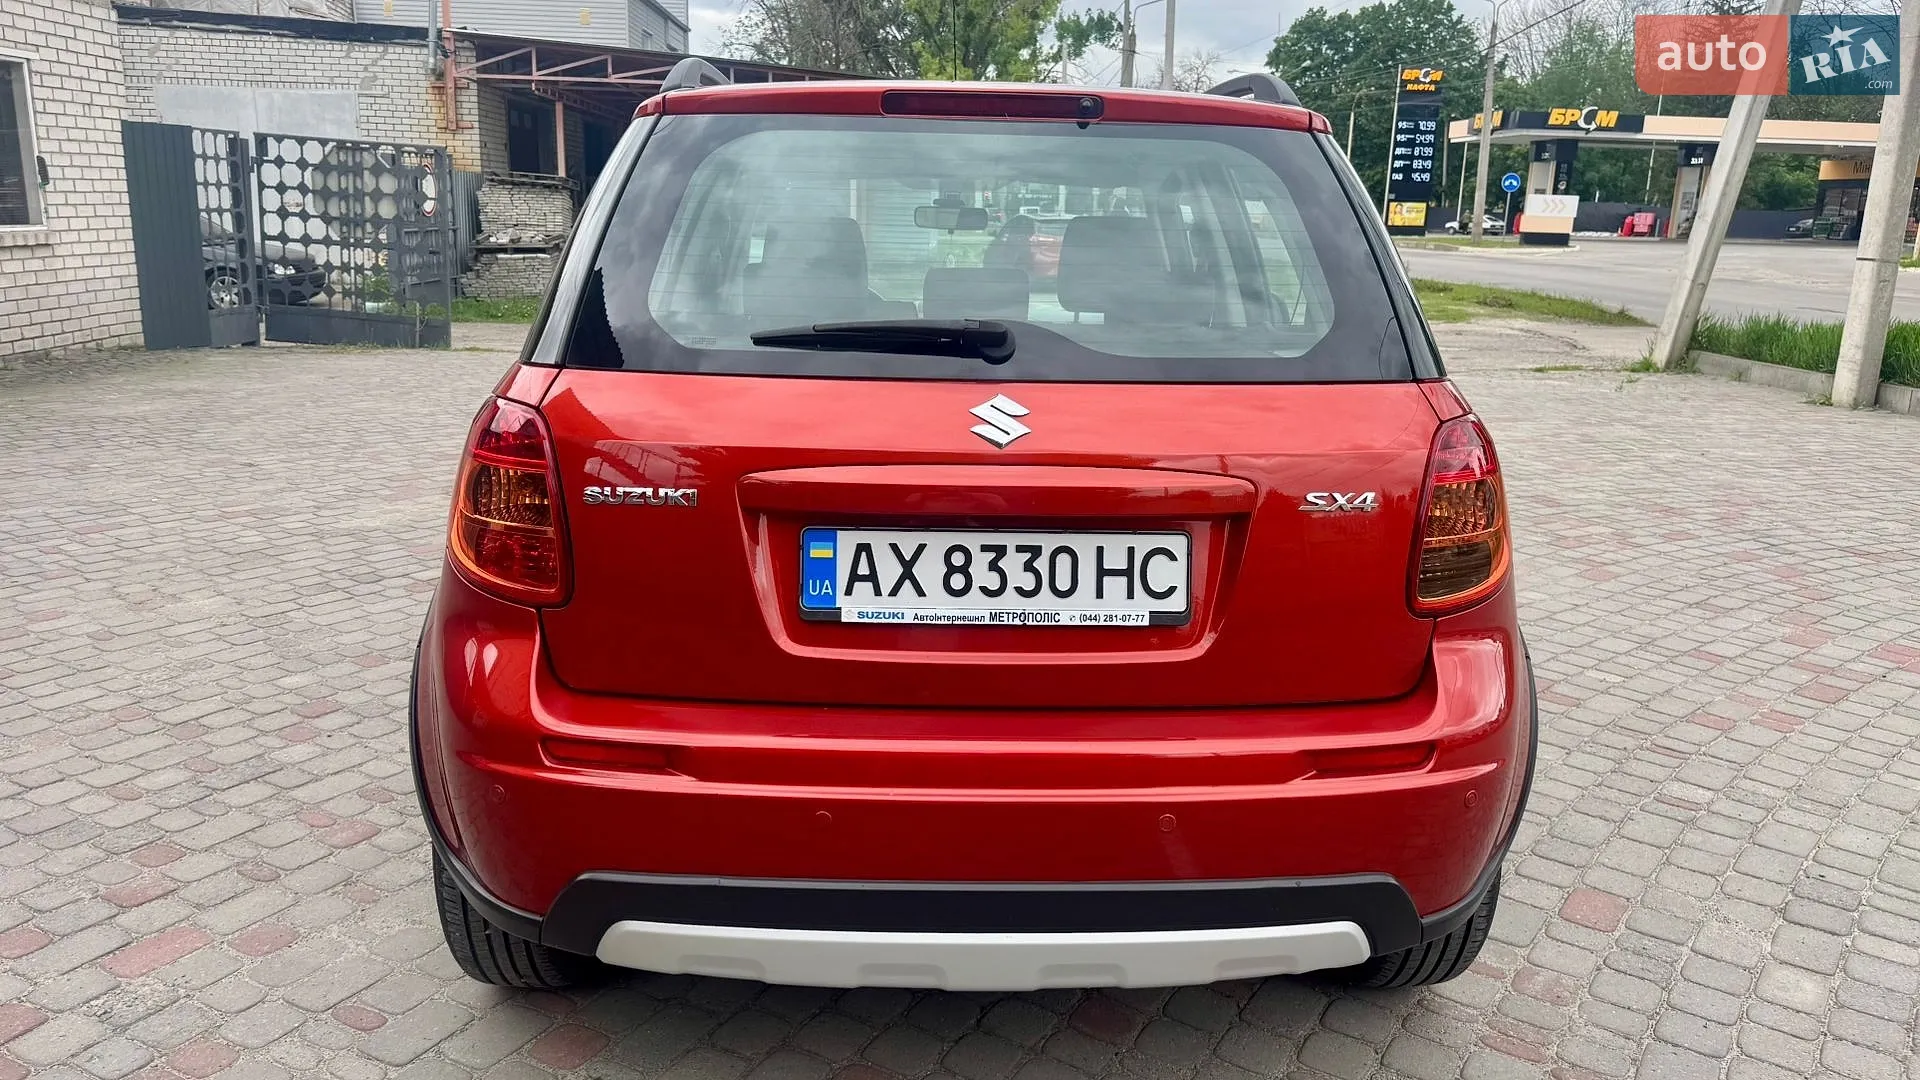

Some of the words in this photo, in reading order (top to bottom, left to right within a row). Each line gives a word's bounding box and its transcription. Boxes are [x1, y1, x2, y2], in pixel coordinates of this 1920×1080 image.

[1402, 68, 1443, 83] БРСМ
[1406, 83, 1435, 91] НАФТА
[1548, 106, 1619, 132] БРСМ
[583, 486, 697, 506] SUZUKI
[1298, 491, 1379, 512] SX4
[844, 542, 928, 597] AX
[942, 543, 1079, 598] 8330
[1095, 545, 1179, 600] HC
[809, 579, 833, 596] UA
[857, 610, 905, 620] SUZUKI
[988, 611, 1061, 623] МЕТРОПОЛІС
[1079, 613, 1101, 624] (044)
[1103, 614, 1145, 623] 281-07-77
